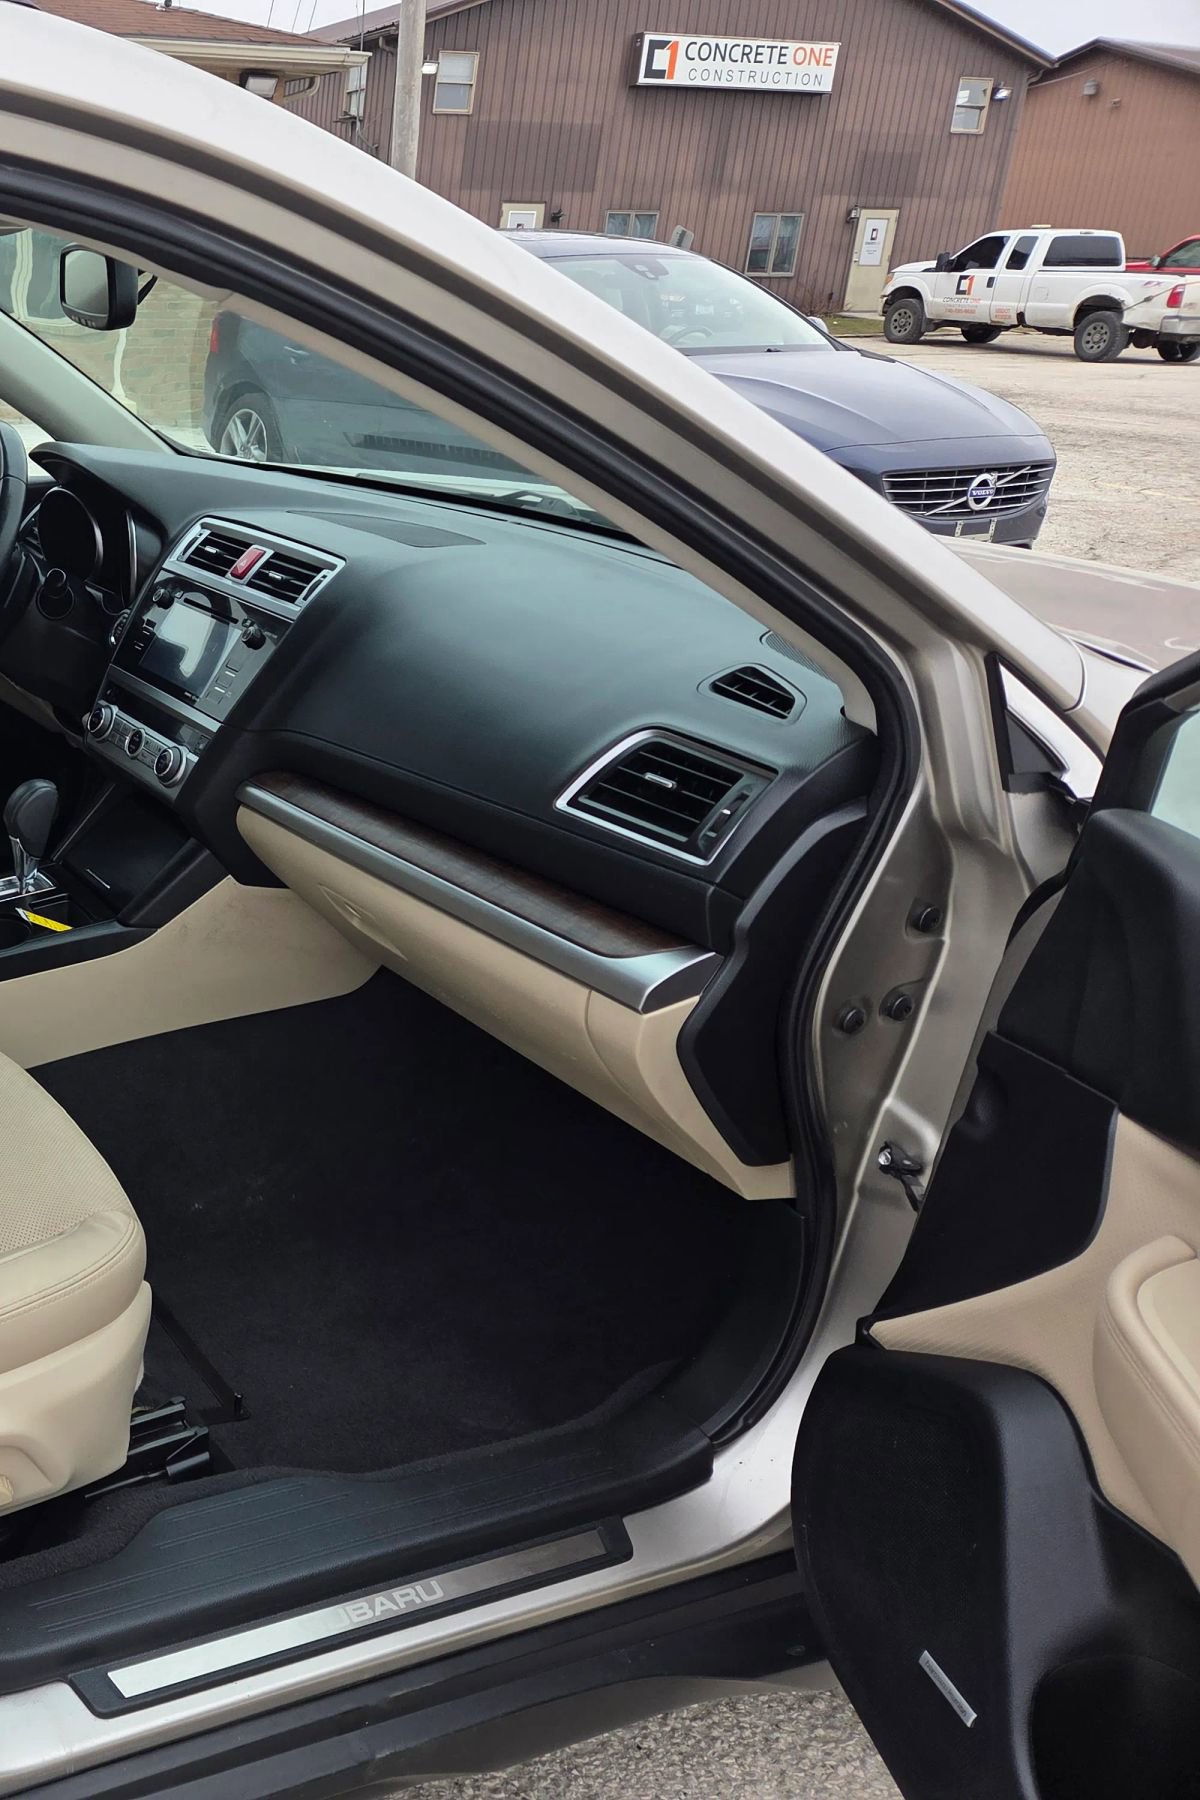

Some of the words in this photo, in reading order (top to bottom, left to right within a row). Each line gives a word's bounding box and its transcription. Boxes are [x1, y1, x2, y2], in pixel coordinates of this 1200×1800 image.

[685, 41, 789, 65] CONCRETE
[792, 46, 835, 67] ONE
[688, 68, 823, 87] CONSTRUCTION
